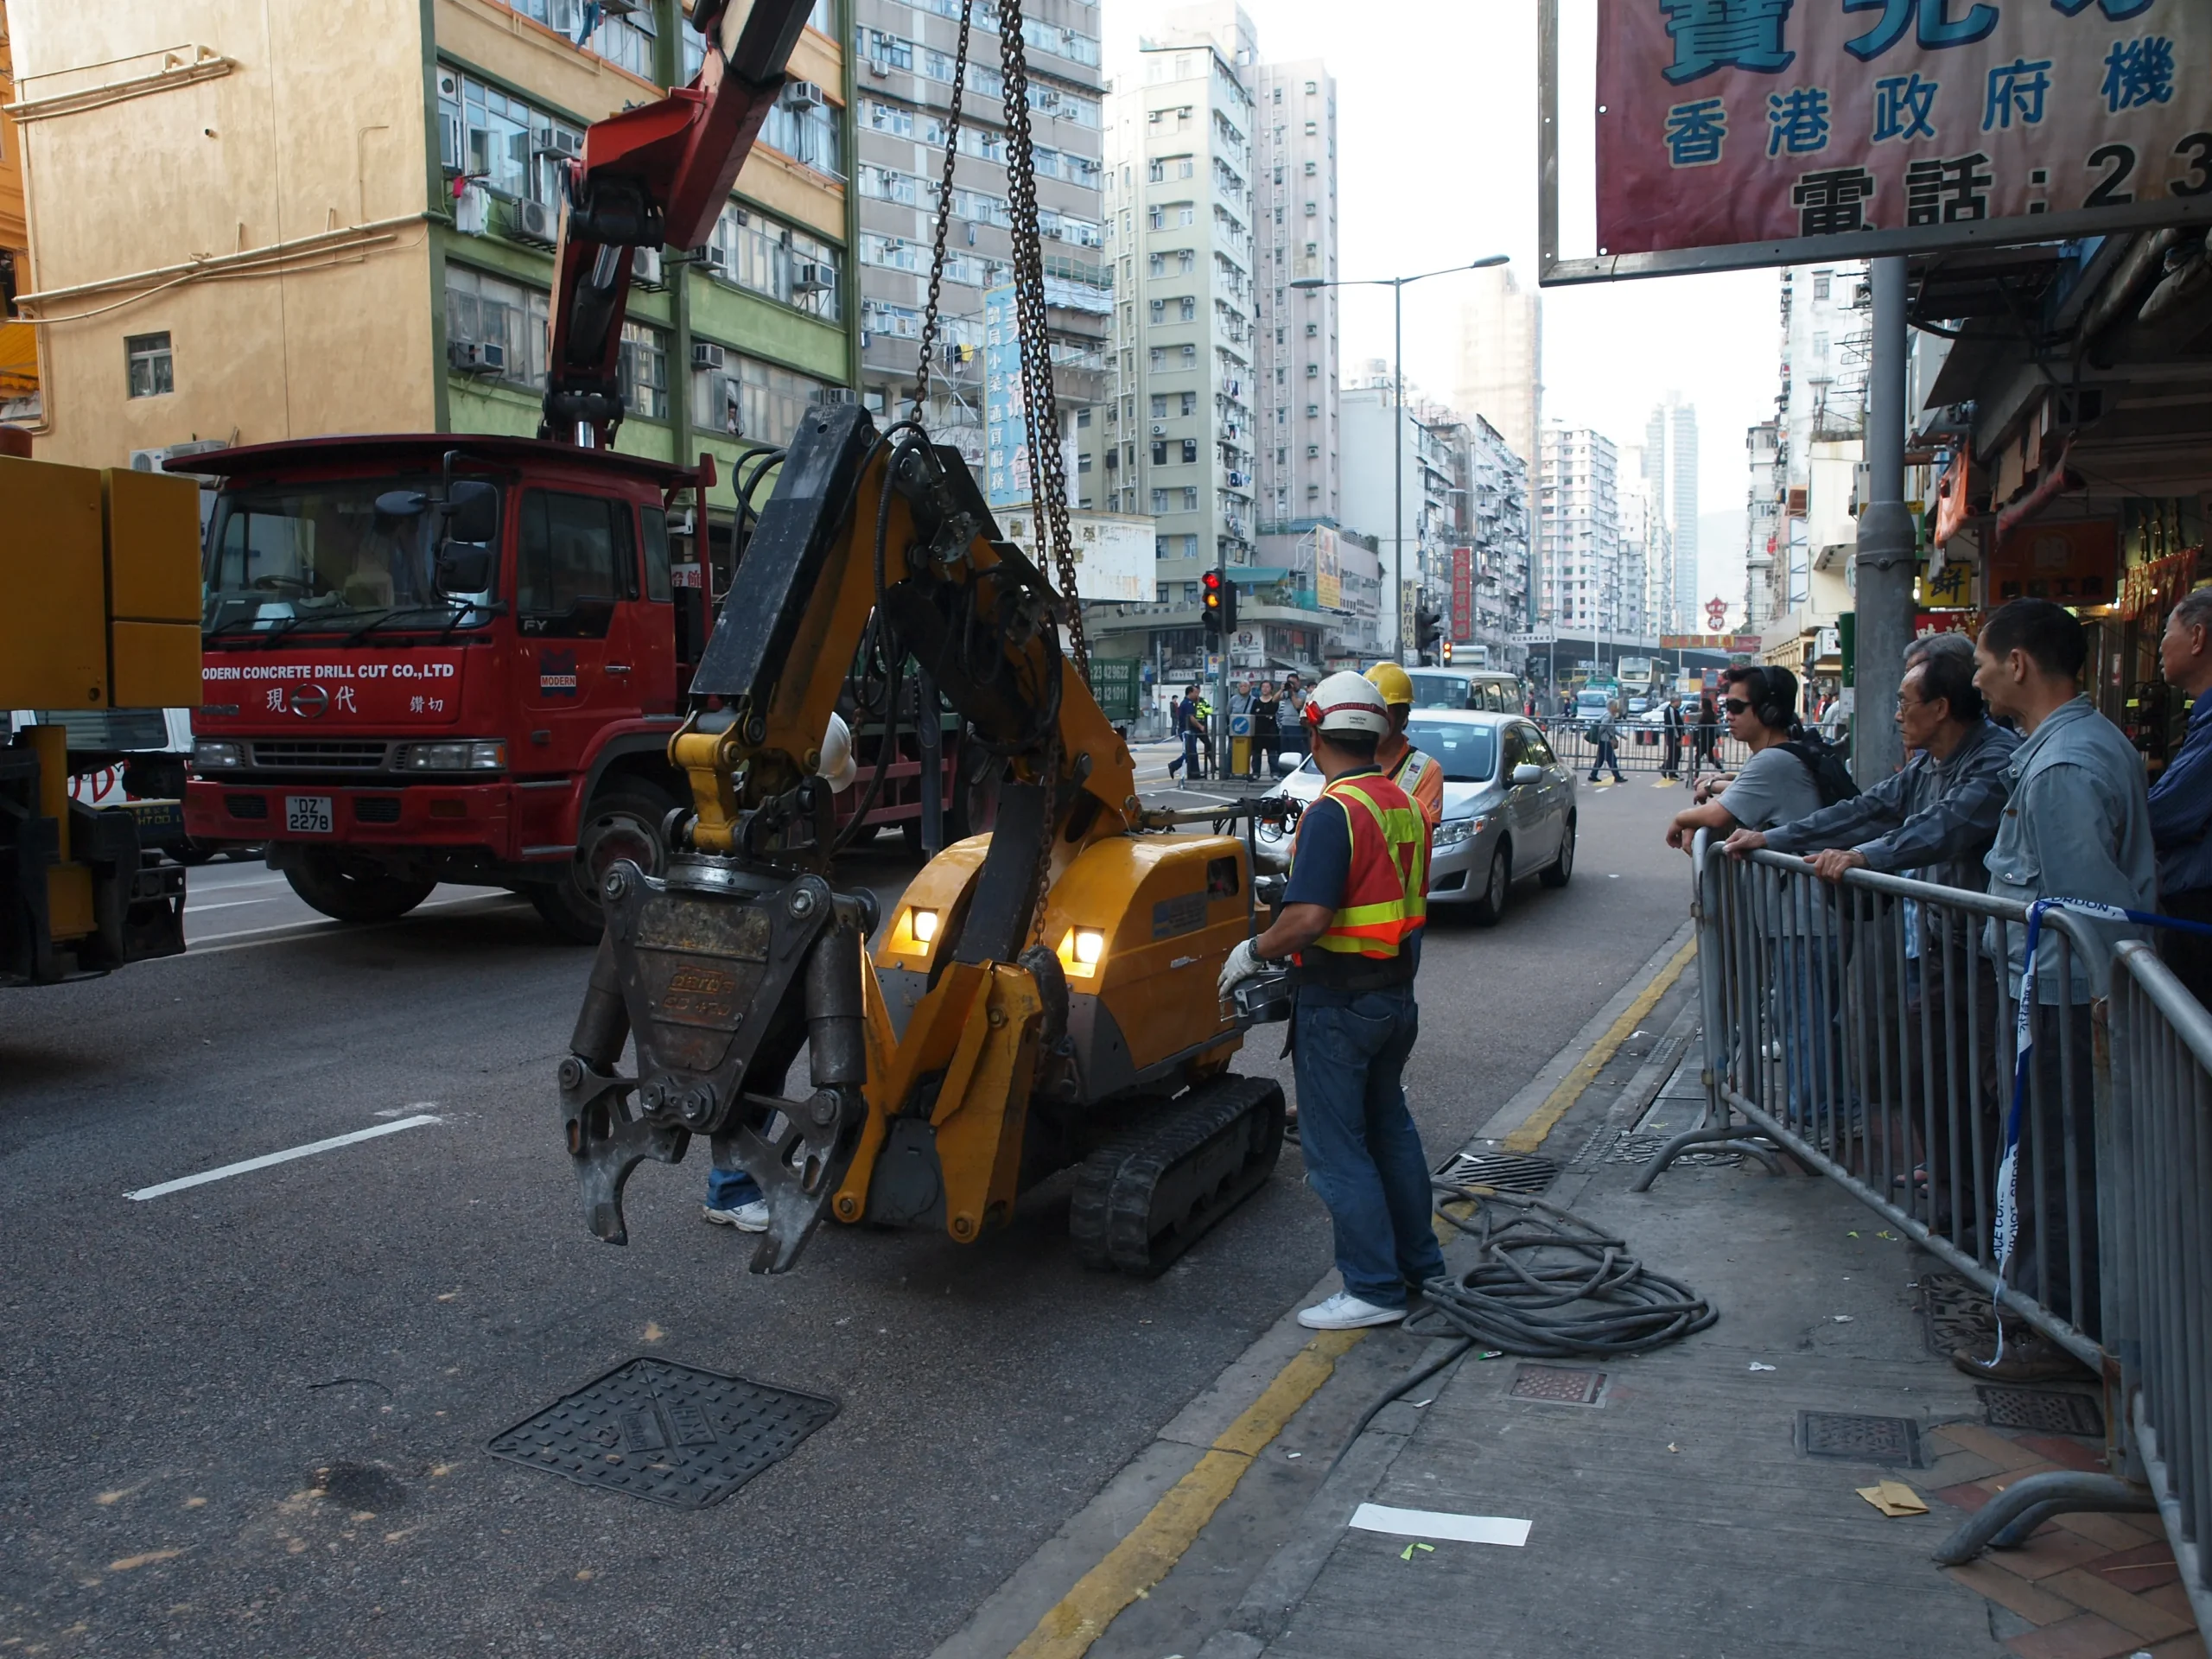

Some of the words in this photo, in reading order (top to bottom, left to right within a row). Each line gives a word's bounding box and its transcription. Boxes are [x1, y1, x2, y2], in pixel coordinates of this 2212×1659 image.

[1666, 35, 2174, 167] 香港政府機
[1402, 580, 1414, 648] 博士教育中心
[523, 620, 548, 631] FY
[202, 666, 240, 680] ODERN
[243, 664, 311, 679] CONCRETE
[315, 664, 354, 678] DRILL
[358, 664, 388, 678] CUT
[542, 677, 575, 685] MODERN
[299, 799, 318, 813] DZ
[289, 814, 329, 831] 2278
